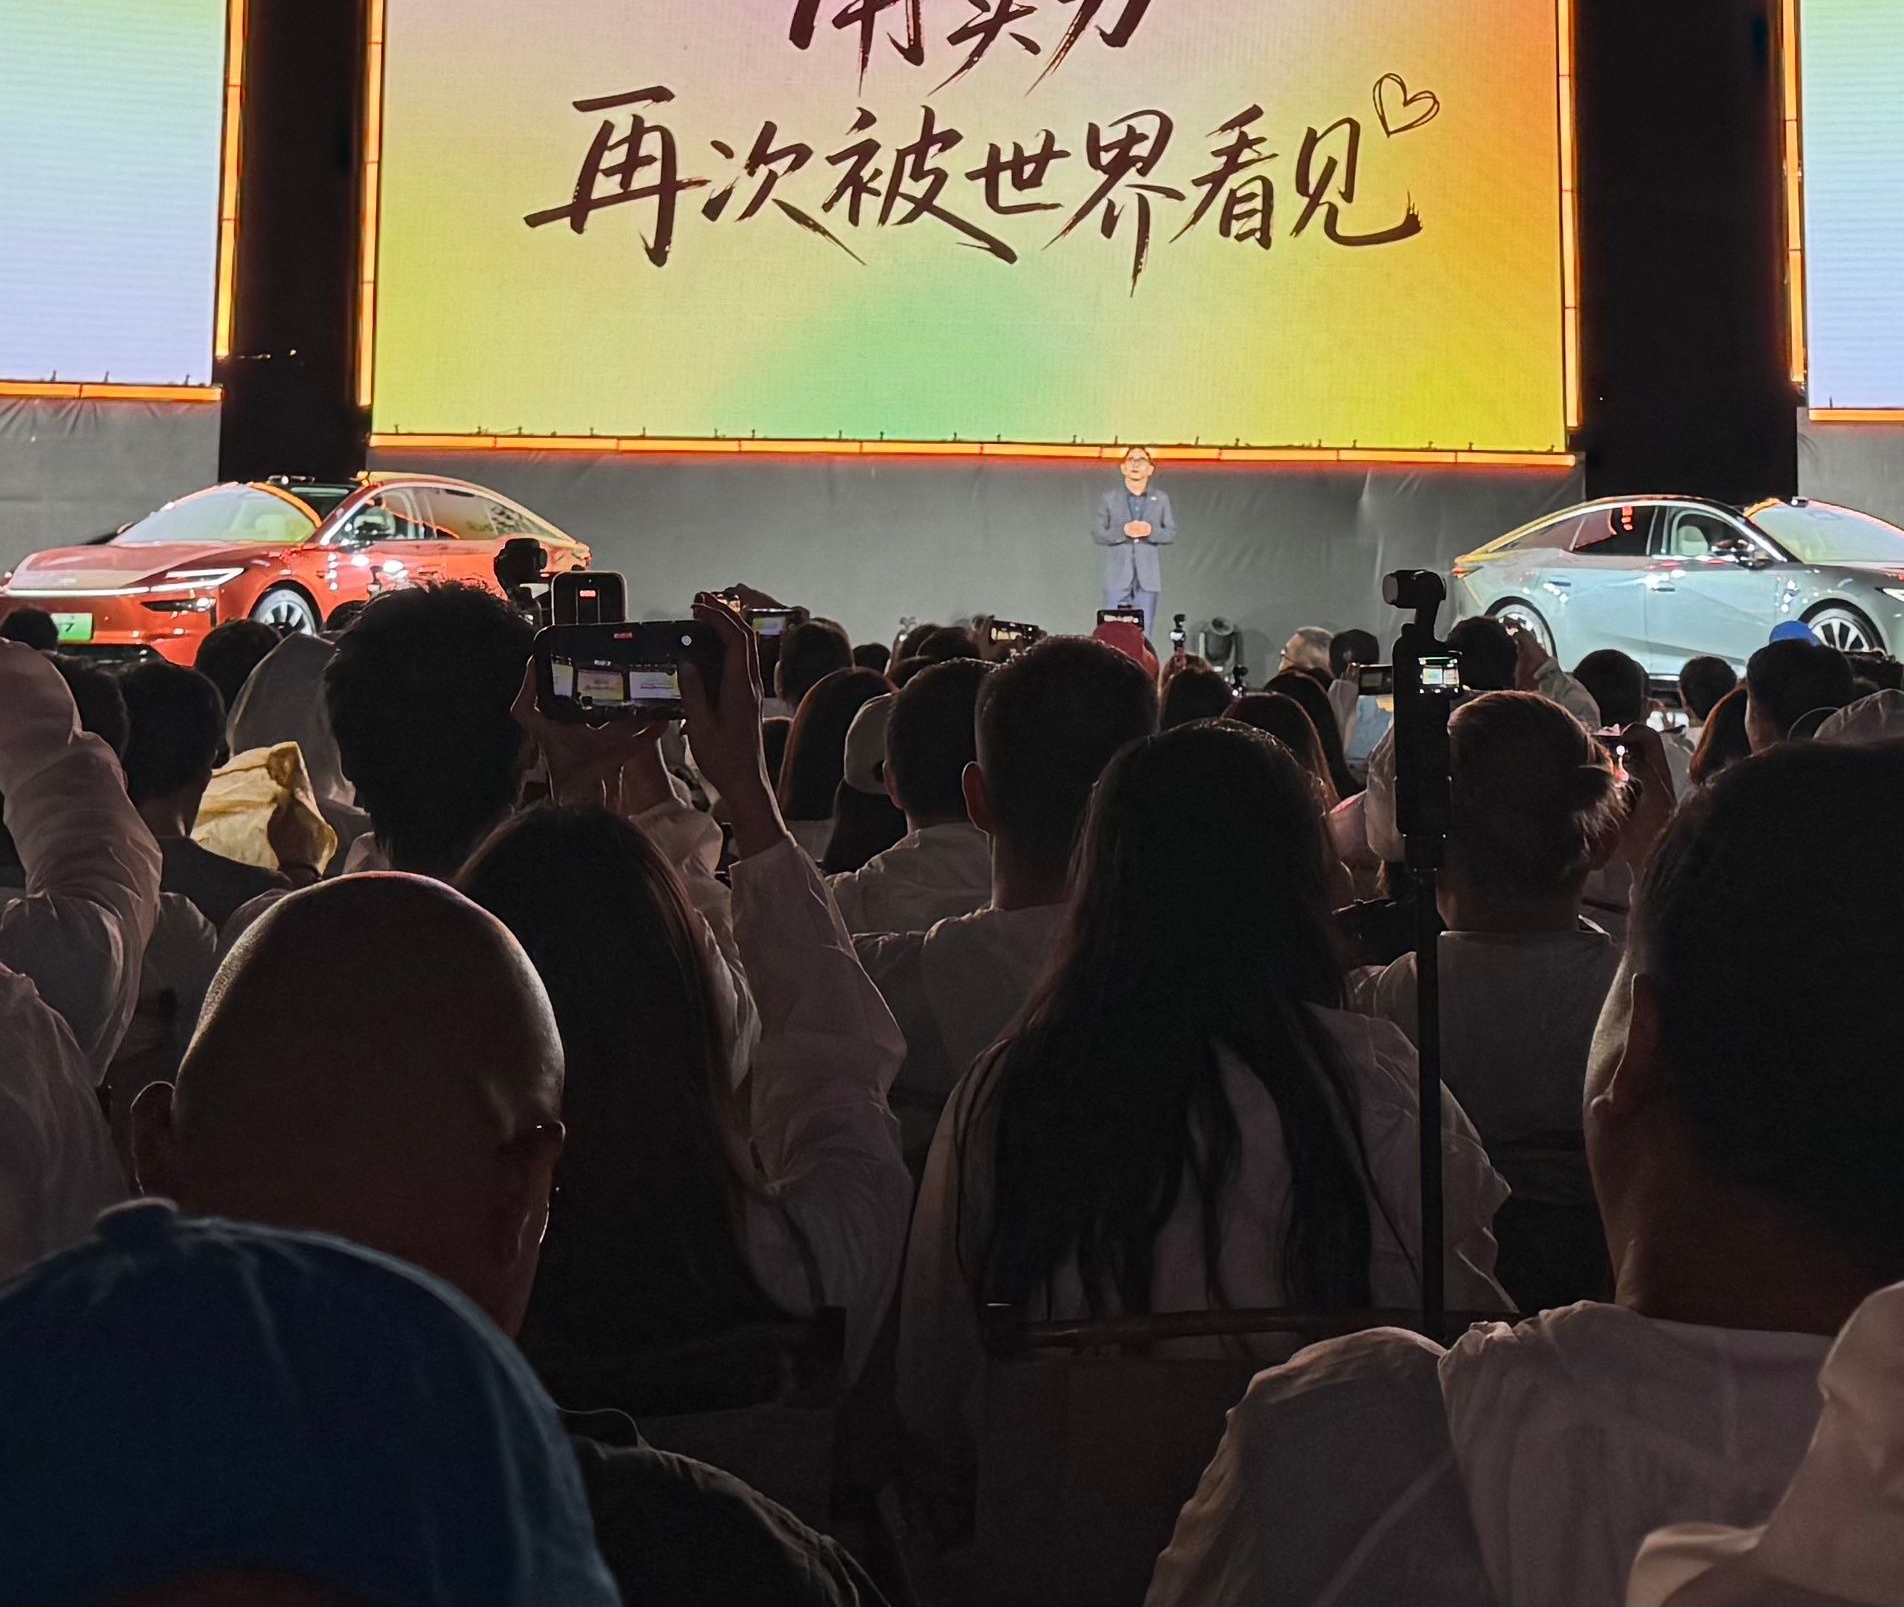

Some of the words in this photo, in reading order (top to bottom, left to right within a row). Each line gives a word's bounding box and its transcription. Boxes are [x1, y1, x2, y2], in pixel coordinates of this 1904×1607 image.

[523, 86, 1422, 297] 再次被世界看见
